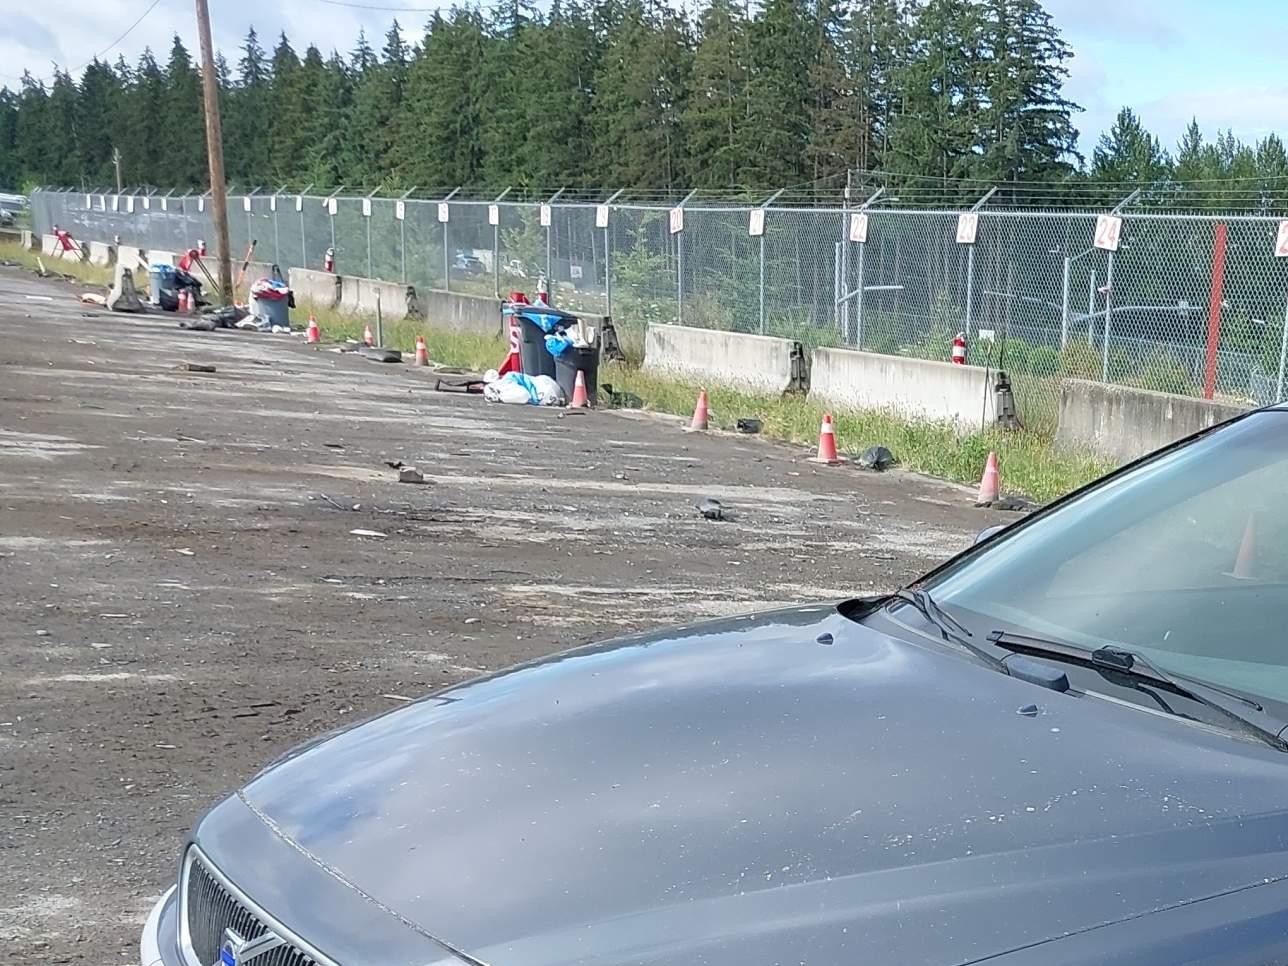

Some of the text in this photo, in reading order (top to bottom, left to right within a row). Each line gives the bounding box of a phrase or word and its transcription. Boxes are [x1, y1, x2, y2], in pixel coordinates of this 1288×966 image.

[852, 216, 865, 239] 22
[959, 215, 975, 241] 23
[1097, 219, 1117, 248] 24
